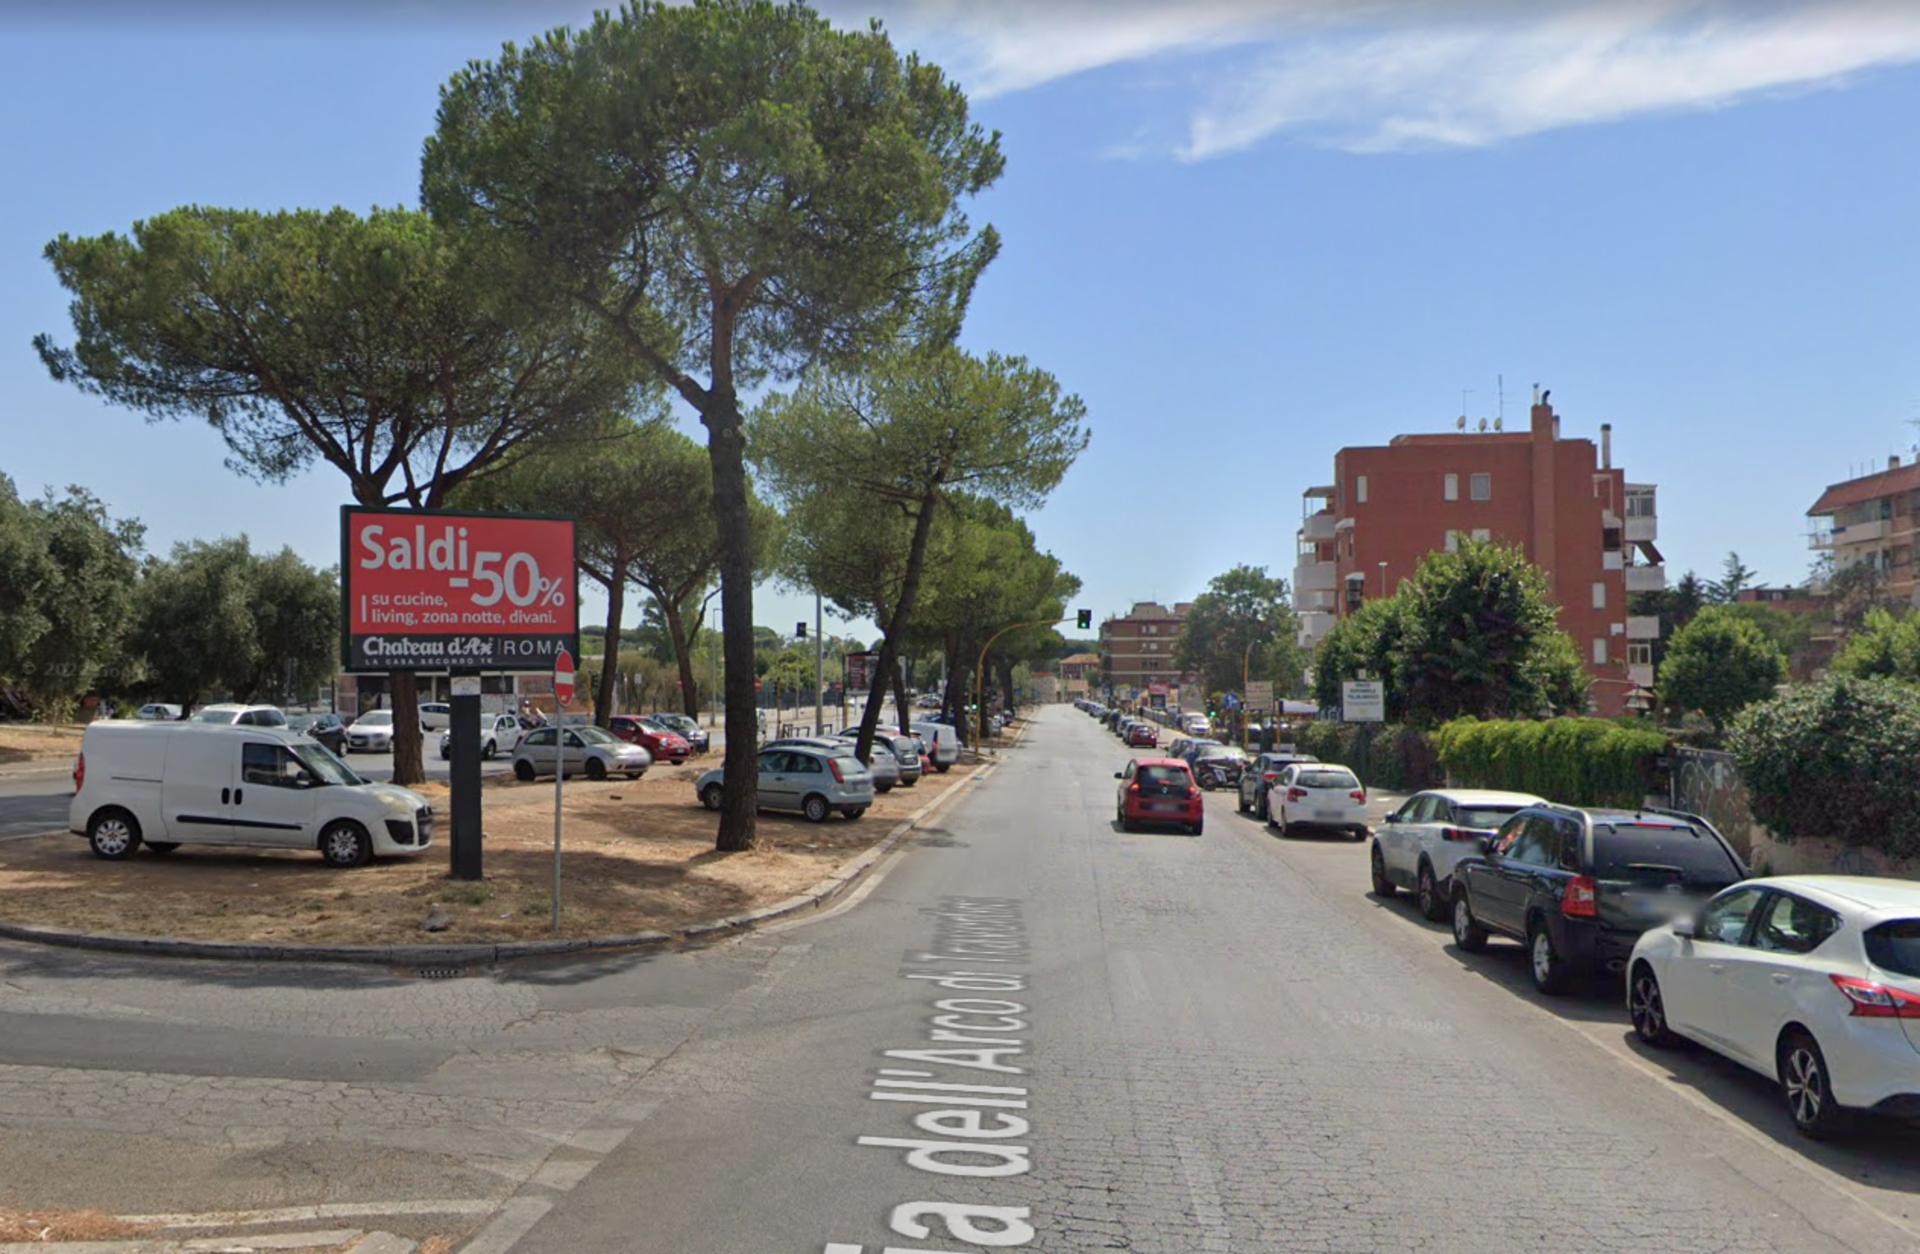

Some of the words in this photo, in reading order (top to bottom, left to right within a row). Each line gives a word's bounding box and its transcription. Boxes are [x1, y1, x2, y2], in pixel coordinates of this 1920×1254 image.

[360, 524, 469, 571] Saldi
[449, 552, 565, 608] -50%
[371, 593, 389, 606] su
[394, 591, 448, 607] cucine,
[371, 610, 418, 625] living,
[422, 611, 458, 624] zona
[462, 611, 505, 625] notte,
[509, 610, 557, 624] divani.
[362, 636, 444, 656] Chateau
[503, 639, 566, 656] ROMA
[365, 658, 378, 666] LA
[420, 657, 474, 665] SECONDO
